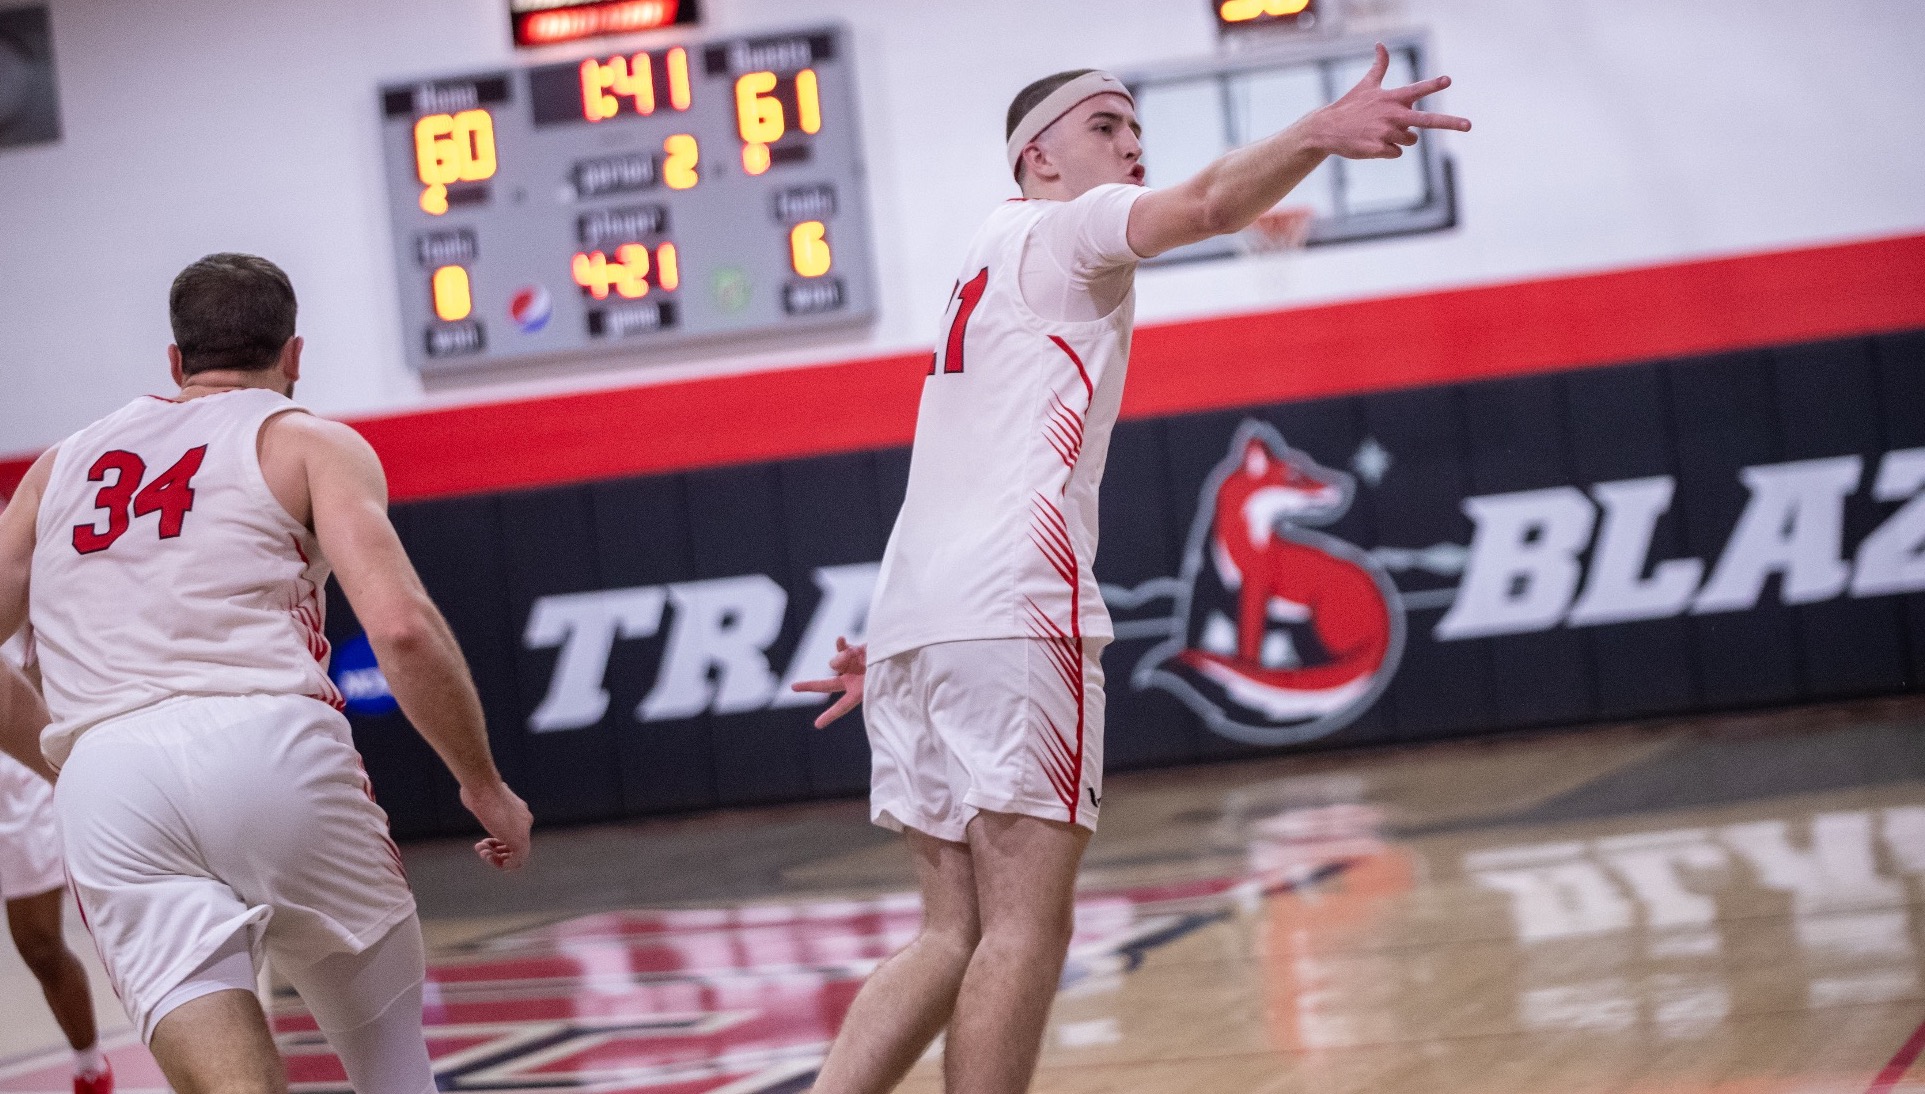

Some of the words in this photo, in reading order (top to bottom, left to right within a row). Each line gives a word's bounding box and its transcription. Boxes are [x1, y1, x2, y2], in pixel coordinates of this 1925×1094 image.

[736, 68, 821, 143] 61
[413, 108, 497, 184] 60
[664, 134, 698, 190] 2
[790, 220, 831, 277] 6
[72, 443, 208, 555] 34
